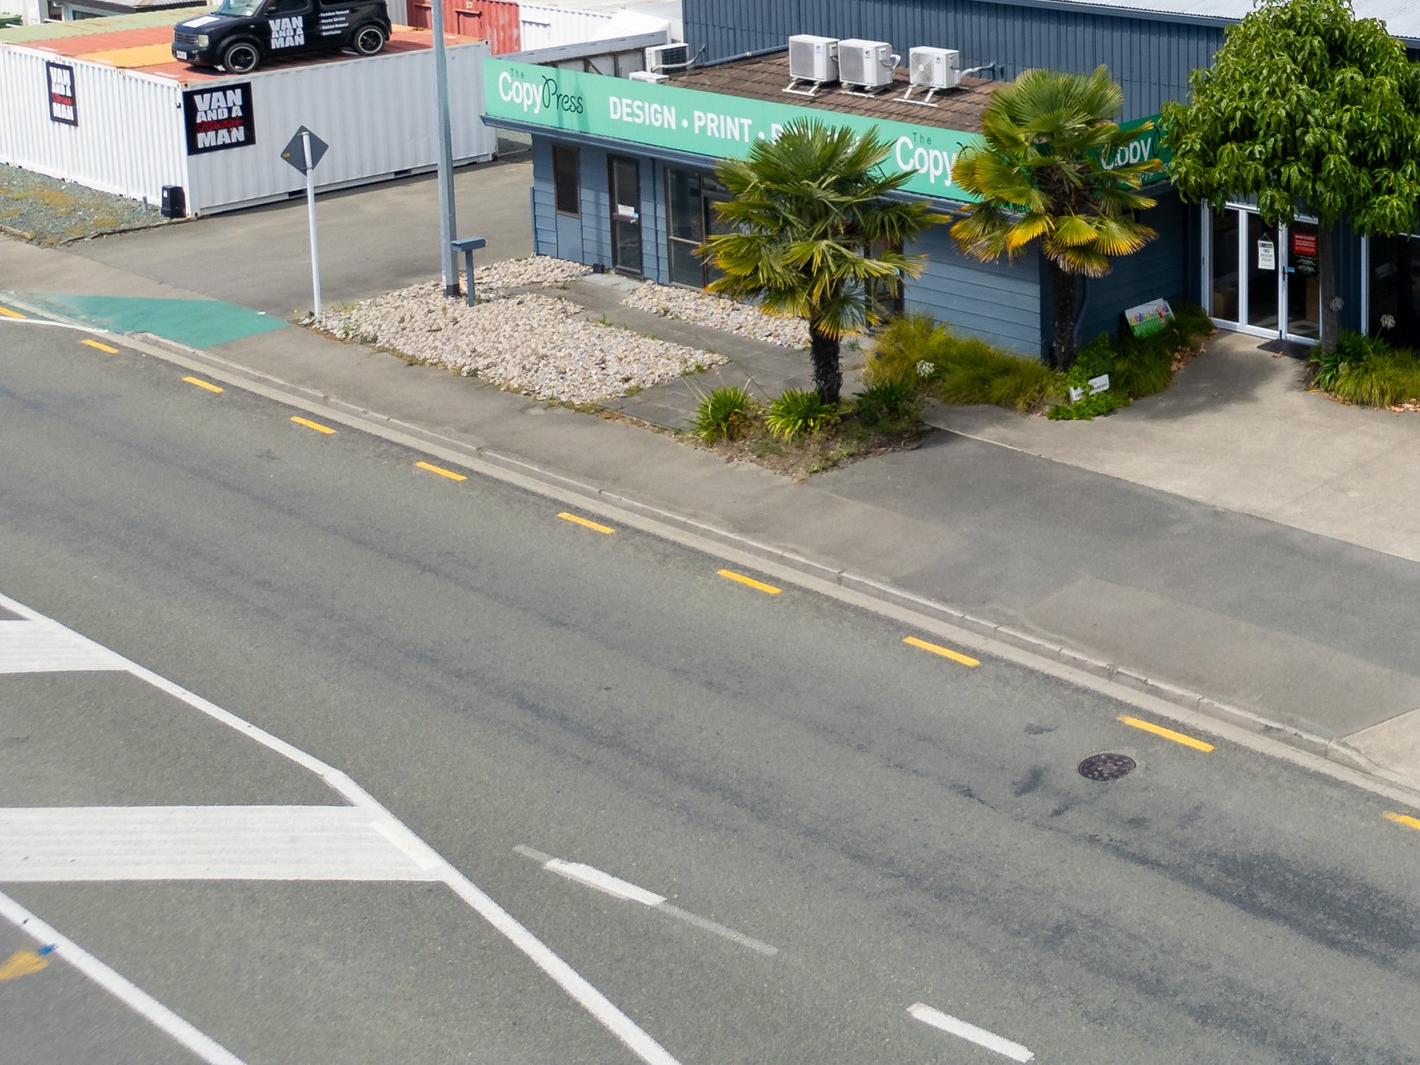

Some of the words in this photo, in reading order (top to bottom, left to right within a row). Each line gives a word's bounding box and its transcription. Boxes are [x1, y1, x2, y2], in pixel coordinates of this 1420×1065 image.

[269, 16, 303, 31] VAN
[271, 29, 294, 38] AND
[295, 28, 304, 36] A
[271, 35, 305, 49] MAN
[49, 66, 71, 86] VAN
[510, 68, 525, 80] The
[193, 88, 243, 111] VAN
[52, 102, 74, 121] MAN
[196, 108, 229, 123] AND
[231, 105, 243, 117] A
[609, 96, 676, 130] DESIGN
[694, 110, 752, 143] PRINT
[197, 126, 245, 149] MAN
[912, 132, 932, 145] The
[895, 136, 952, 185] Copy
